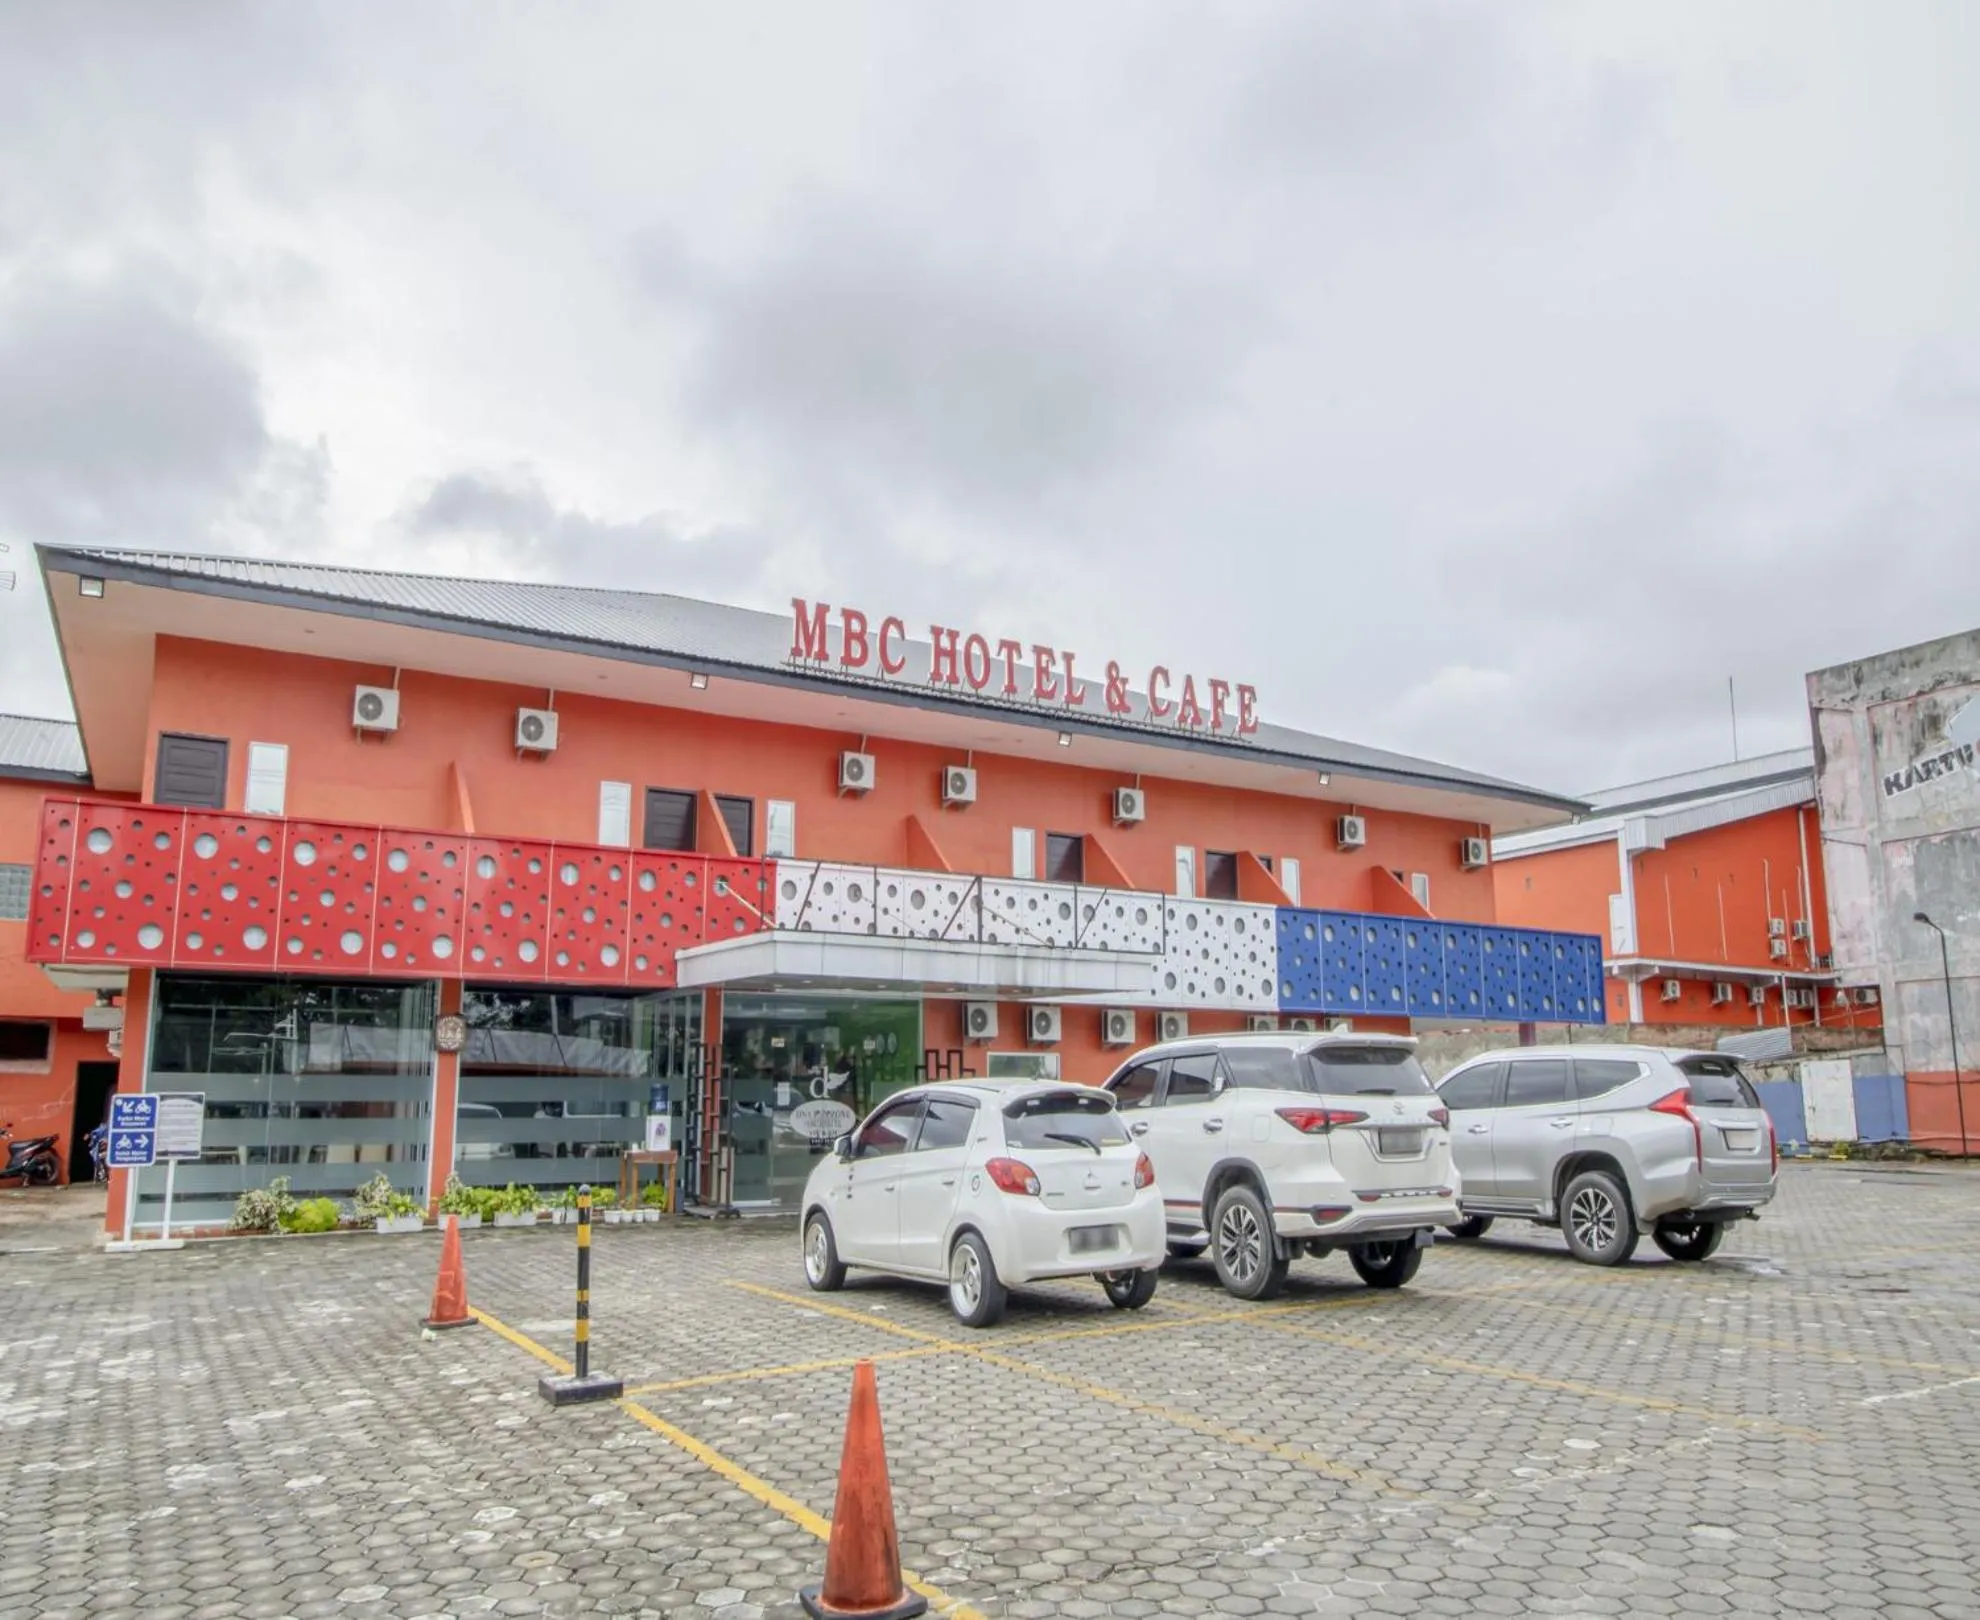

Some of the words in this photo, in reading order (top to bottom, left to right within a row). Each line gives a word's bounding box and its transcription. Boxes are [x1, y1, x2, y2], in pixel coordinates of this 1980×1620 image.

[791, 597, 906, 676] MBC
[928, 624, 1086, 706] HOTEL
[1104, 659, 1132, 714] &
[1147, 664, 1259, 735] CAFE
